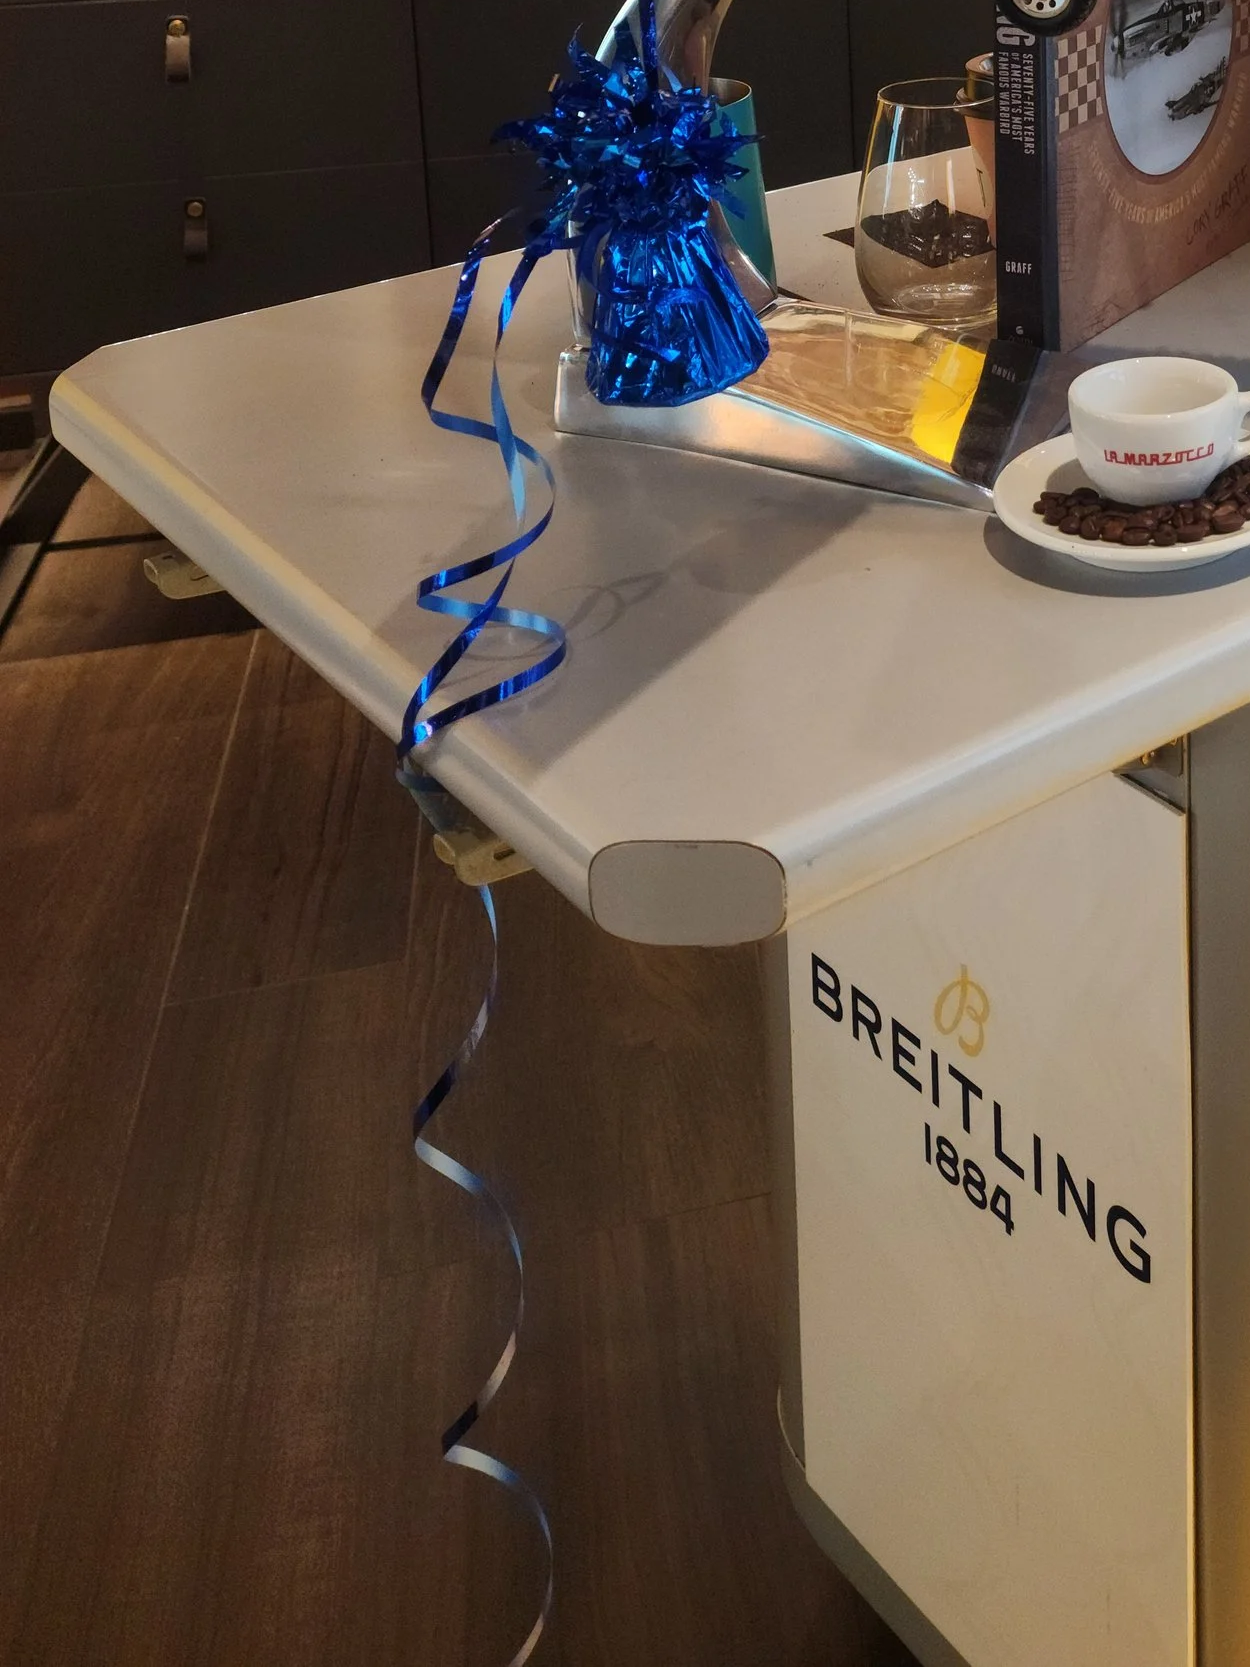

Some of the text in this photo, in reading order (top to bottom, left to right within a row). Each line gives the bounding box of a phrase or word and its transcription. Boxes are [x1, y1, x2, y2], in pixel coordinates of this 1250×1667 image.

[998, 52, 1010, 135] FAMOUS WARBIRD
[1010, 64, 1022, 114] AMERICA'S
[1011, 115, 1022, 142] MOST
[1022, 53, 1035, 155] SEVENTY-FIVE YEARS
[1005, 260, 1032, 275] GRAFF
[811, 952, 1151, 1284] BREITLING
[924, 1121, 1014, 1236] 1884
